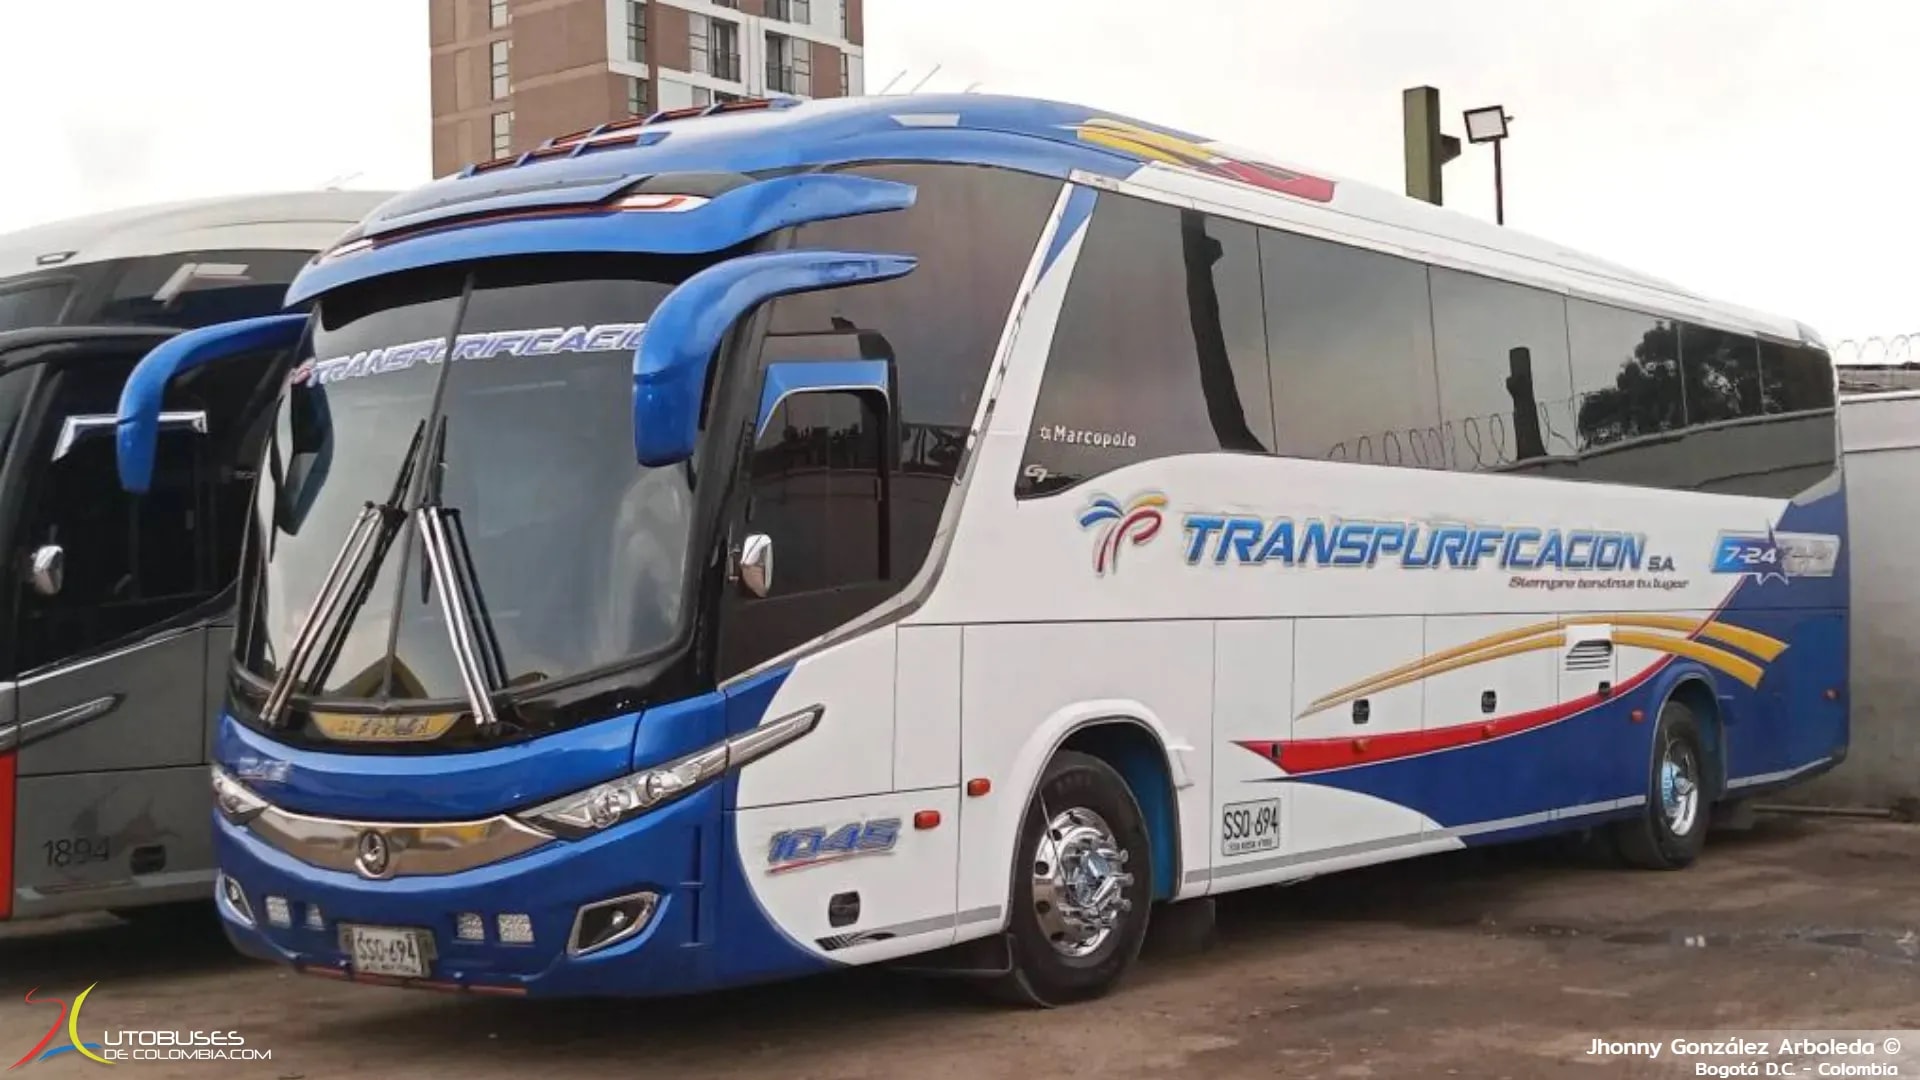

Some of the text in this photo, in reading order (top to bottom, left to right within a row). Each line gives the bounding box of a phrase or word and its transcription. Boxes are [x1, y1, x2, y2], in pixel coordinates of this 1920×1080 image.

[1053, 424, 1137, 448] Marcopolo
[1184, 514, 1646, 572] TRANSPURIFICACION
[1722, 546, 1777, 564] 7-24
[41, 836, 109, 867] 1894
[768, 817, 902, 863] 1045
